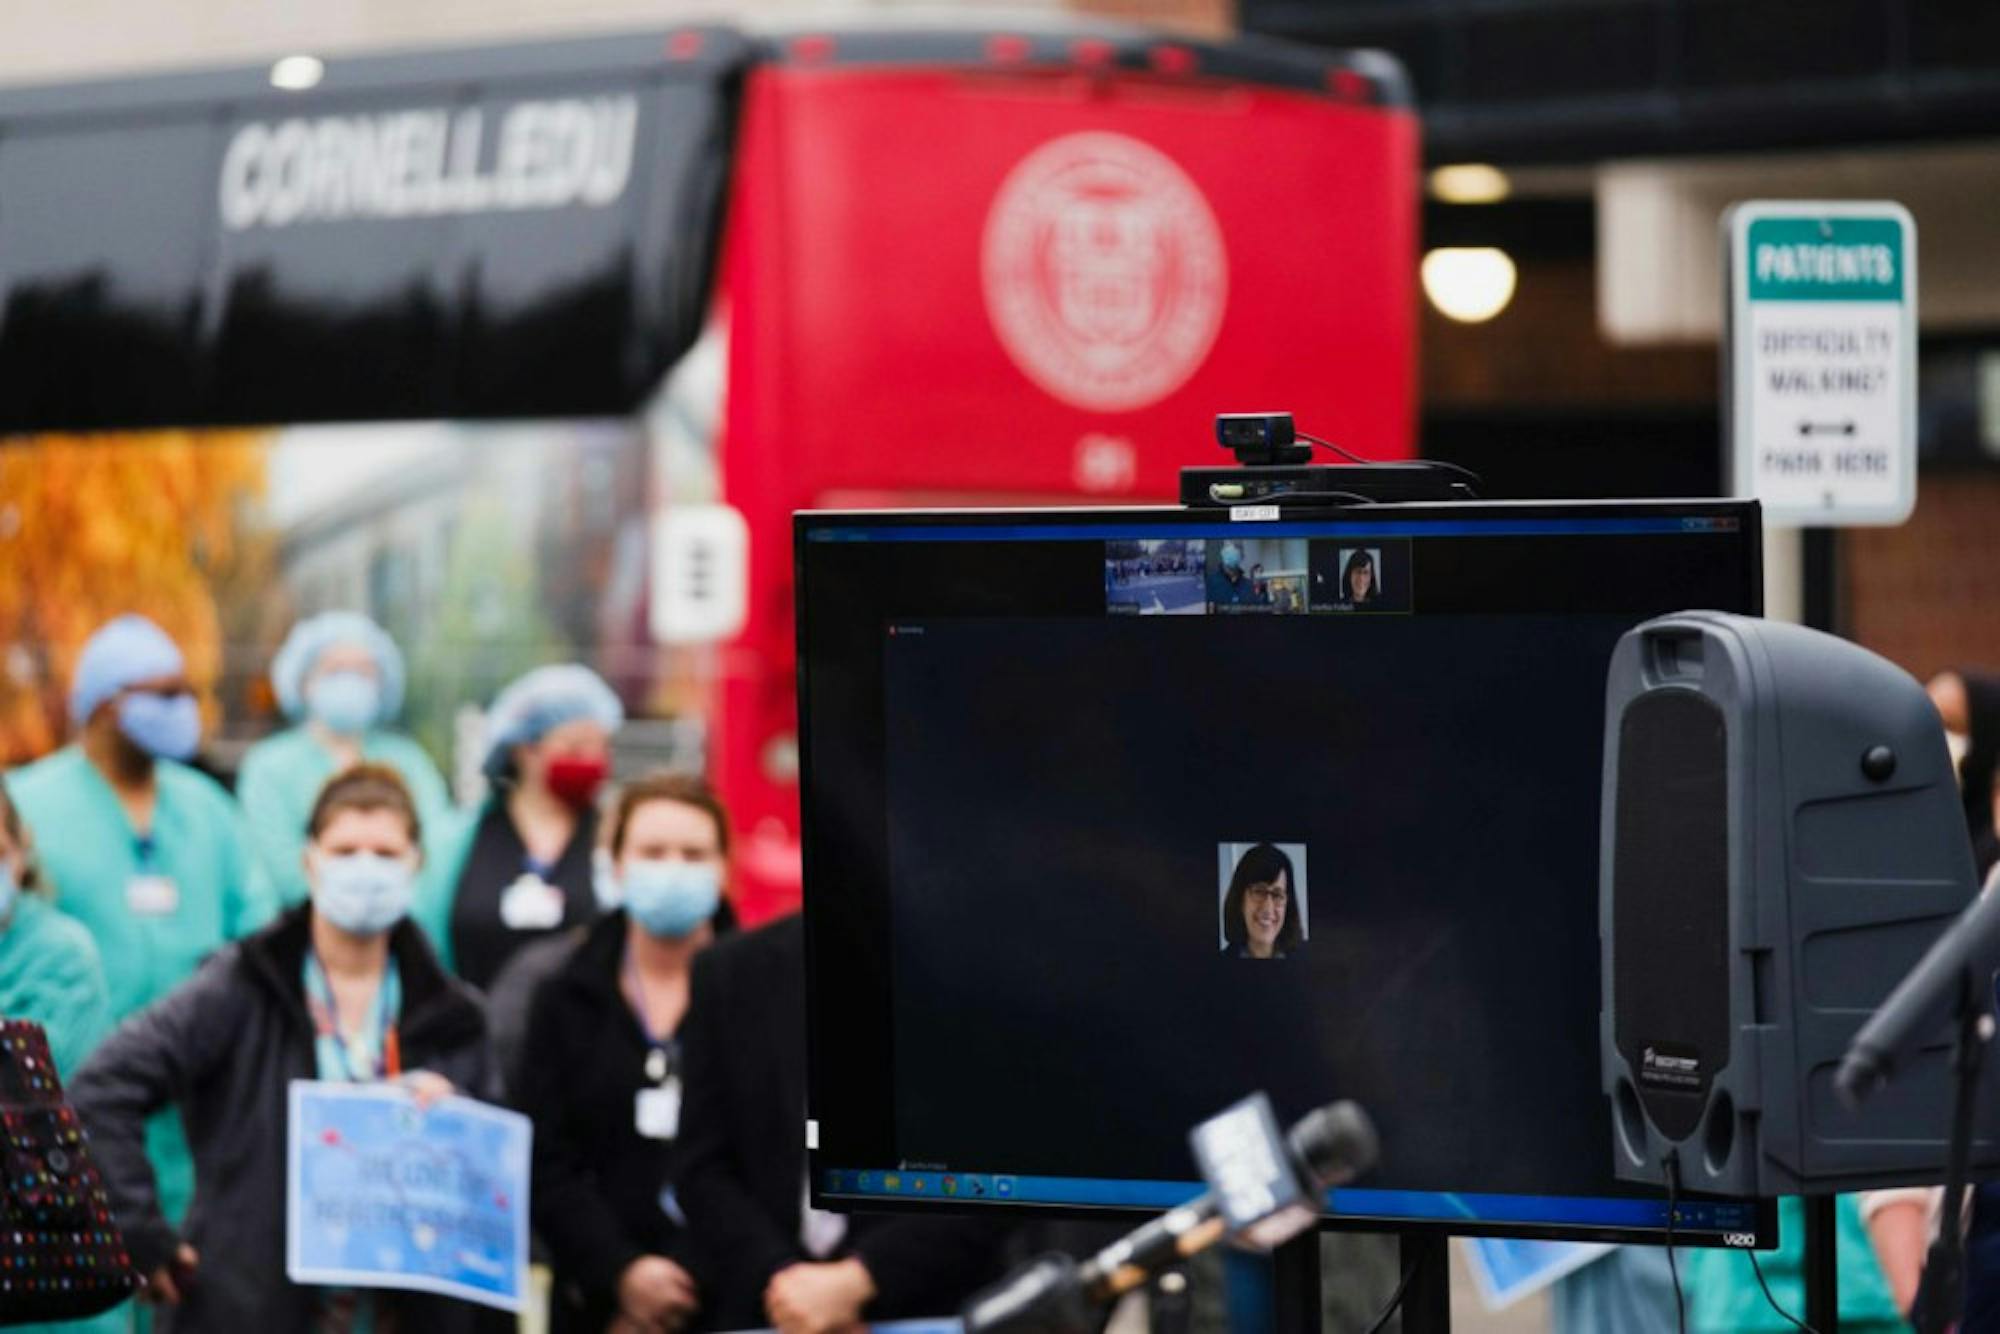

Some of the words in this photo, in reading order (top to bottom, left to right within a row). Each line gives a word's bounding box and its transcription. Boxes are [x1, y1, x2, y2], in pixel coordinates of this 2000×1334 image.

[1757, 244, 1895, 284] PATIENTS
[1762, 329, 1891, 354] DIFFICULTY
[1723, 1232, 1756, 1247] VIZIO
